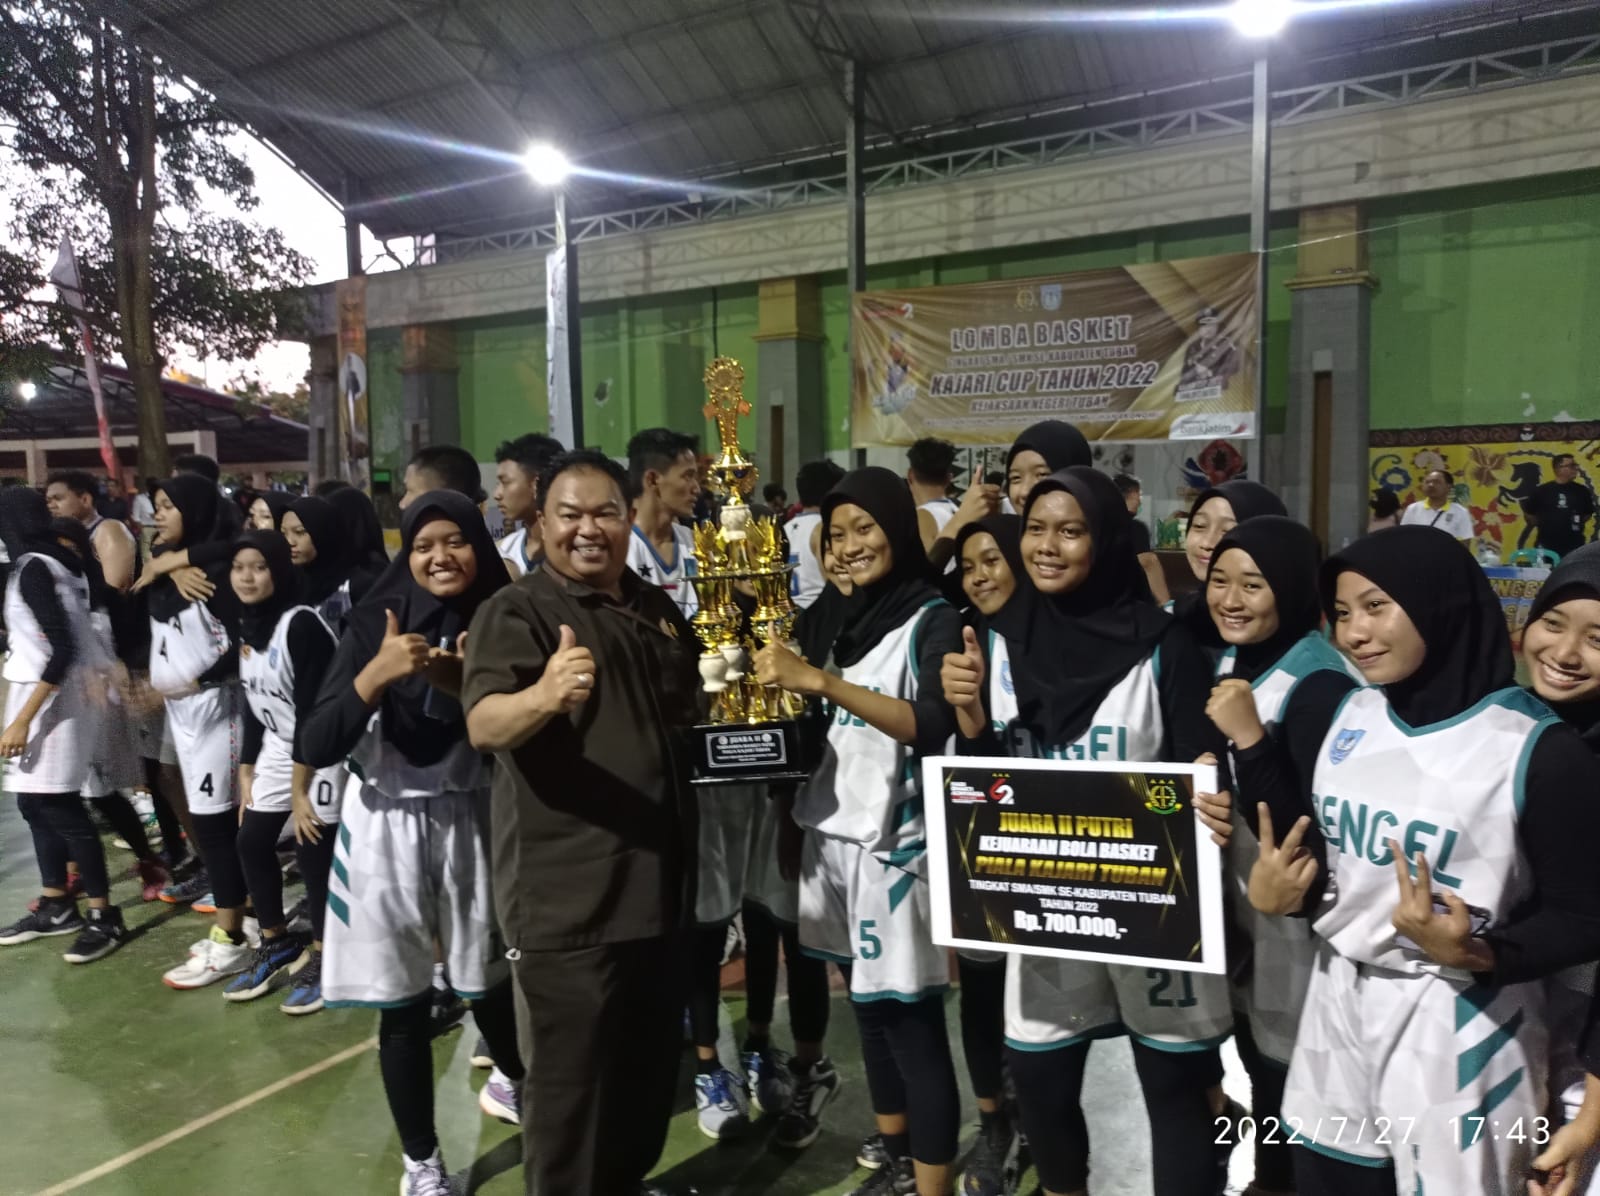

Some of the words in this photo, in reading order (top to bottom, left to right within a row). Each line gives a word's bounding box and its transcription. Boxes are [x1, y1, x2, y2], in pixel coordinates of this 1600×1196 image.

[950, 324, 1030, 352] LOMBA
[1034, 315, 1132, 346] BASKET
[929, 372, 996, 397] KAJARI
[994, 369, 1035, 394] CUP
[1036, 365, 1103, 392] TAHUN
[1100, 361, 1159, 389] 2022
[1071, 393, 1110, 409] TUBAN
[199, 772, 214, 798] 4
[998, 811, 1056, 835] JUARA
[1057, 814, 1074, 835] II
[1075, 816, 1134, 839] PUTRI
[979, 835, 1058, 855] KEJUARAAN
[1059, 840, 1097, 858] BOLA
[1099, 842, 1158, 862] BASKET
[975, 855, 1026, 876] PIALA
[1028, 859, 1097, 881] KAJARI
[1099, 863, 1168, 887] TUBAN
[968, 879, 1010, 892] TINGKAT
[1058, 886, 1137, 902] SE-KABUPATEN
[1138, 892, 1176, 905] TUBAN
[1038, 898, 1074, 911] TAHUN
[1074, 900, 1099, 913] 2022
[1013, 909, 1043, 932] Rp.
[1043, 912, 1128, 940] 700.000,-
[859, 919, 883, 960] 5
[1146, 966, 1198, 1008] 21
